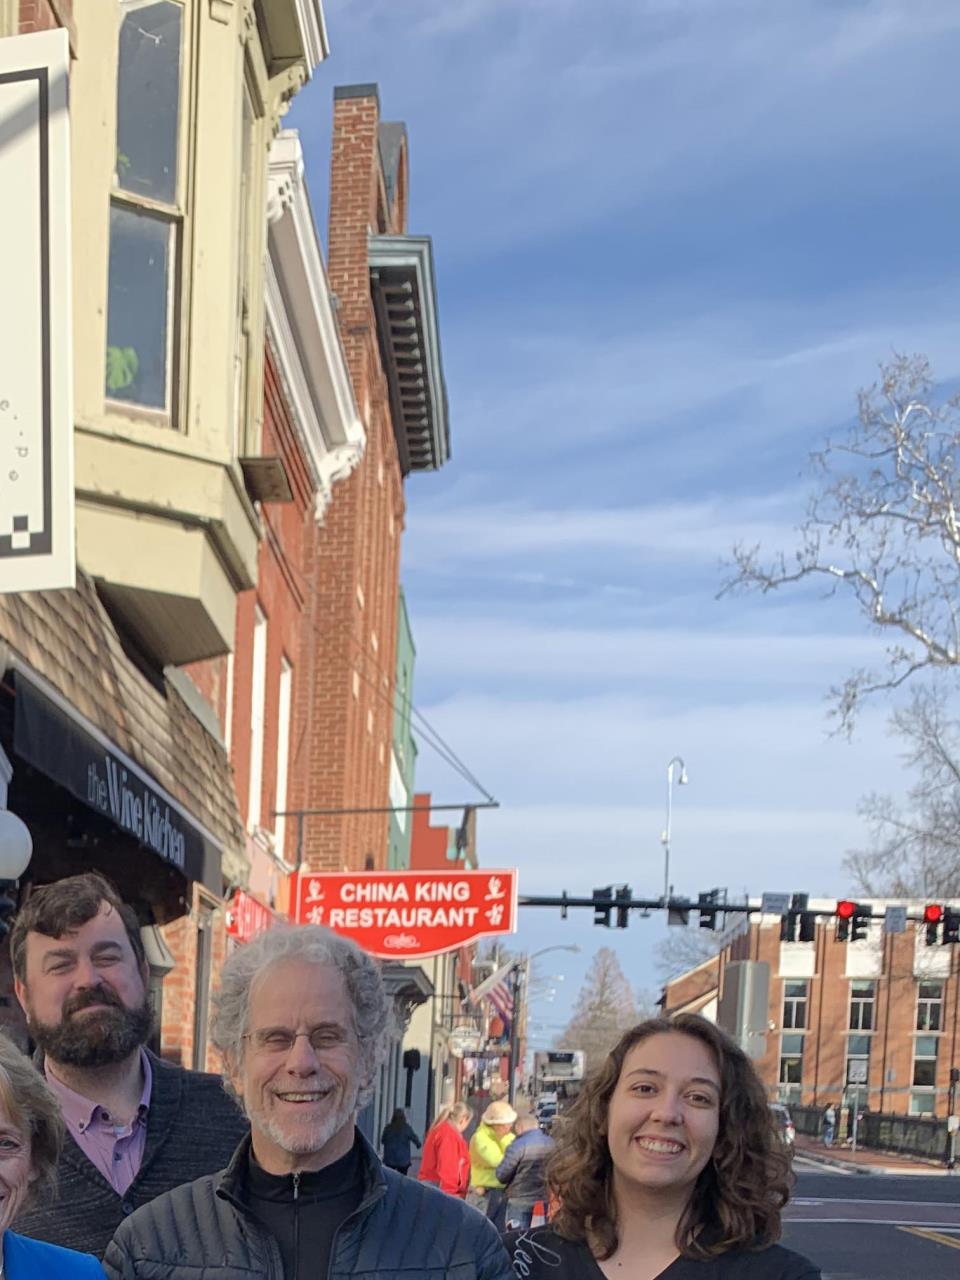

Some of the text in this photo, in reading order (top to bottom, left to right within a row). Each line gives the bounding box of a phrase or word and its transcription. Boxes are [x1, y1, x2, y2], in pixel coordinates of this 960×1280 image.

[340, 882, 410, 903] CHINA
[415, 881, 470, 901] KING
[329, 907, 479, 928] RESTAURANT
